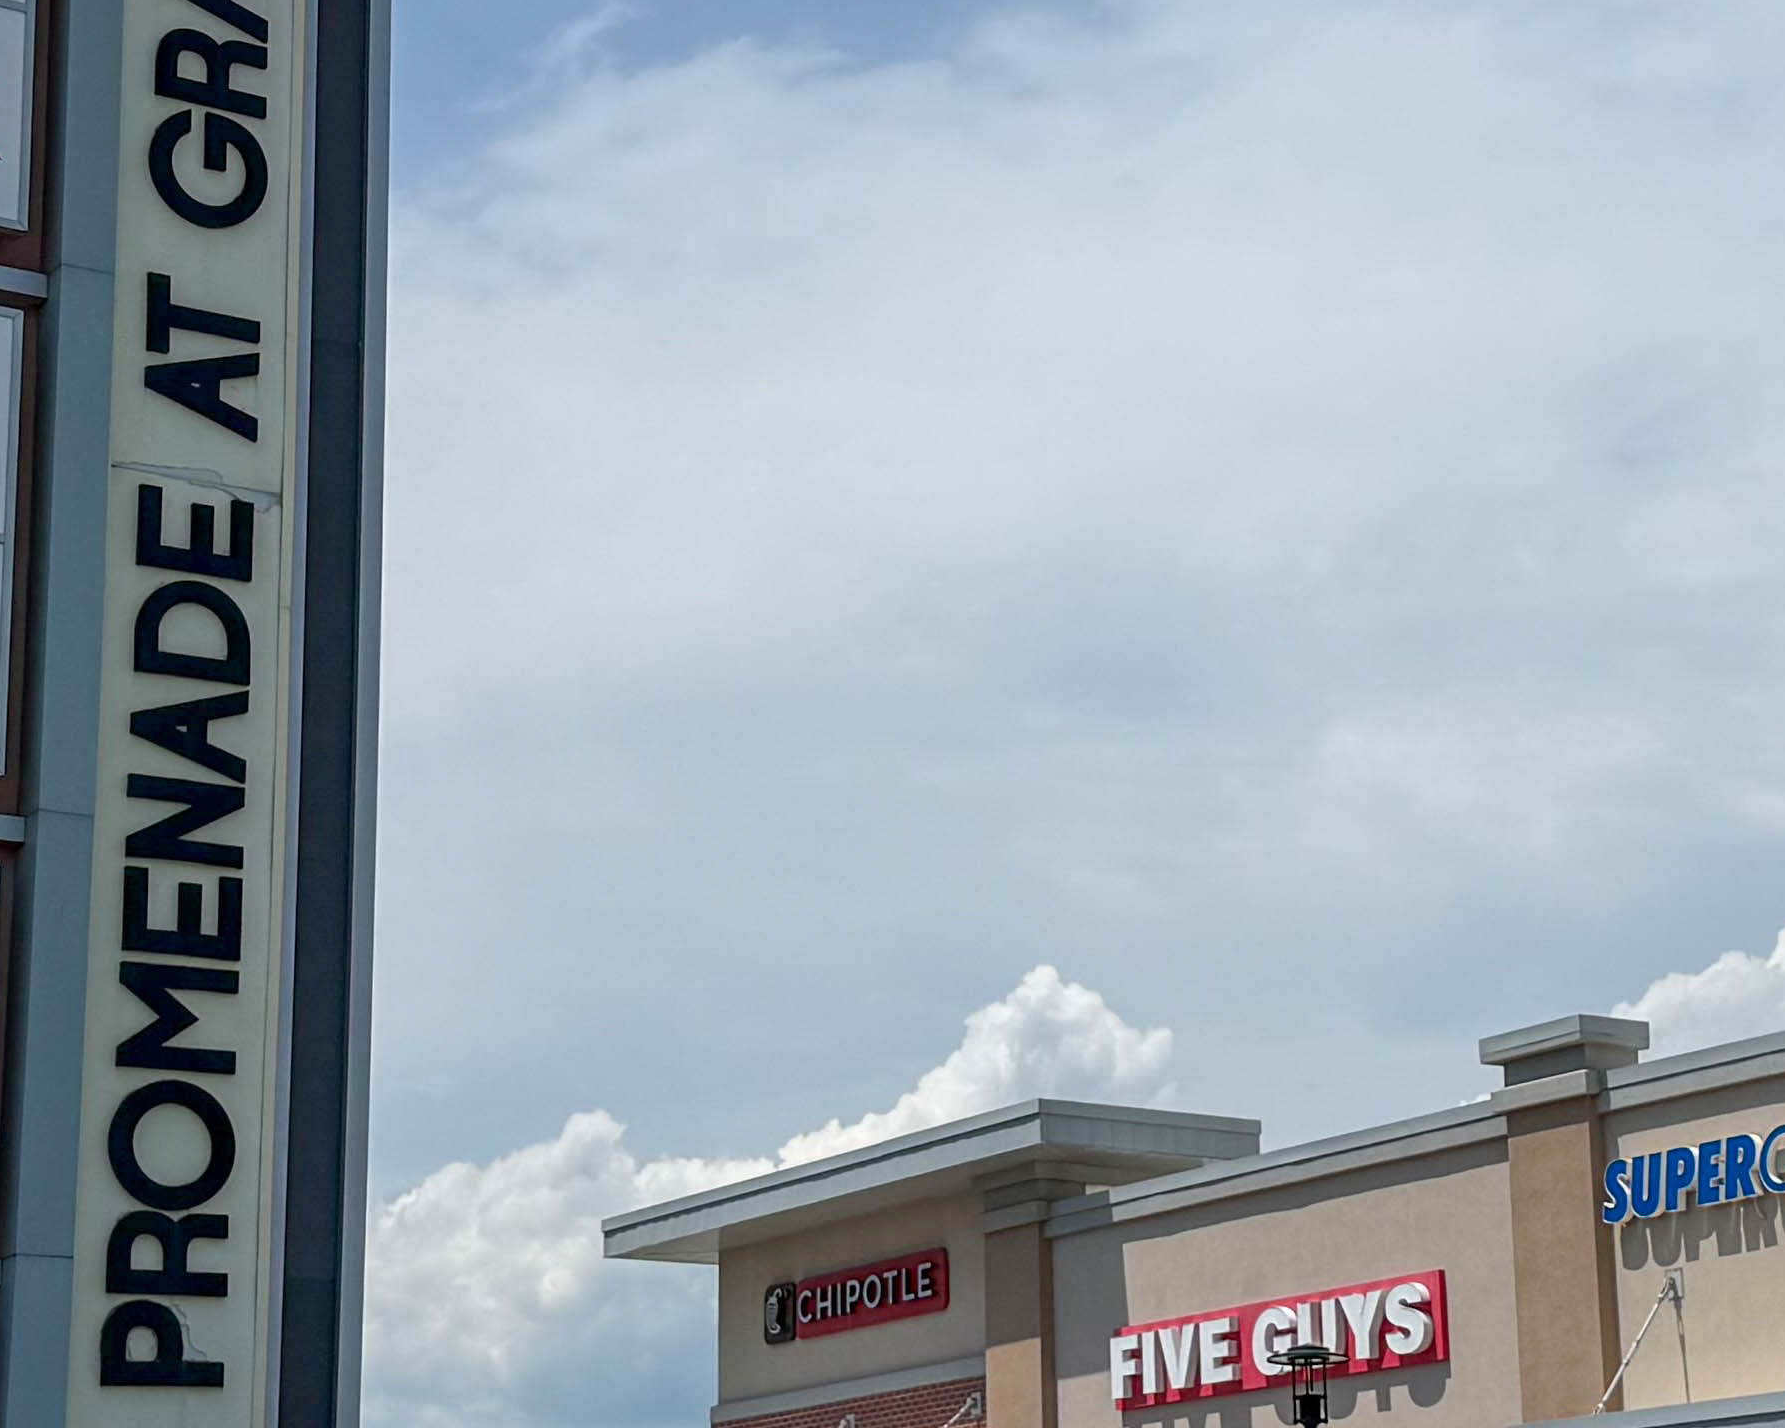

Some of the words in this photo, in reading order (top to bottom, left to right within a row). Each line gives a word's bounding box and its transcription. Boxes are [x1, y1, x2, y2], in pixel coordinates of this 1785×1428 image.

[143, 270, 264, 445] AT
[99, 484, 256, 1389] PROMENADE
[796, 1259, 935, 1325] CHIPOTLE
[1109, 1314, 1243, 1402] FIVE
[1250, 1280, 1435, 1377] GUYS
